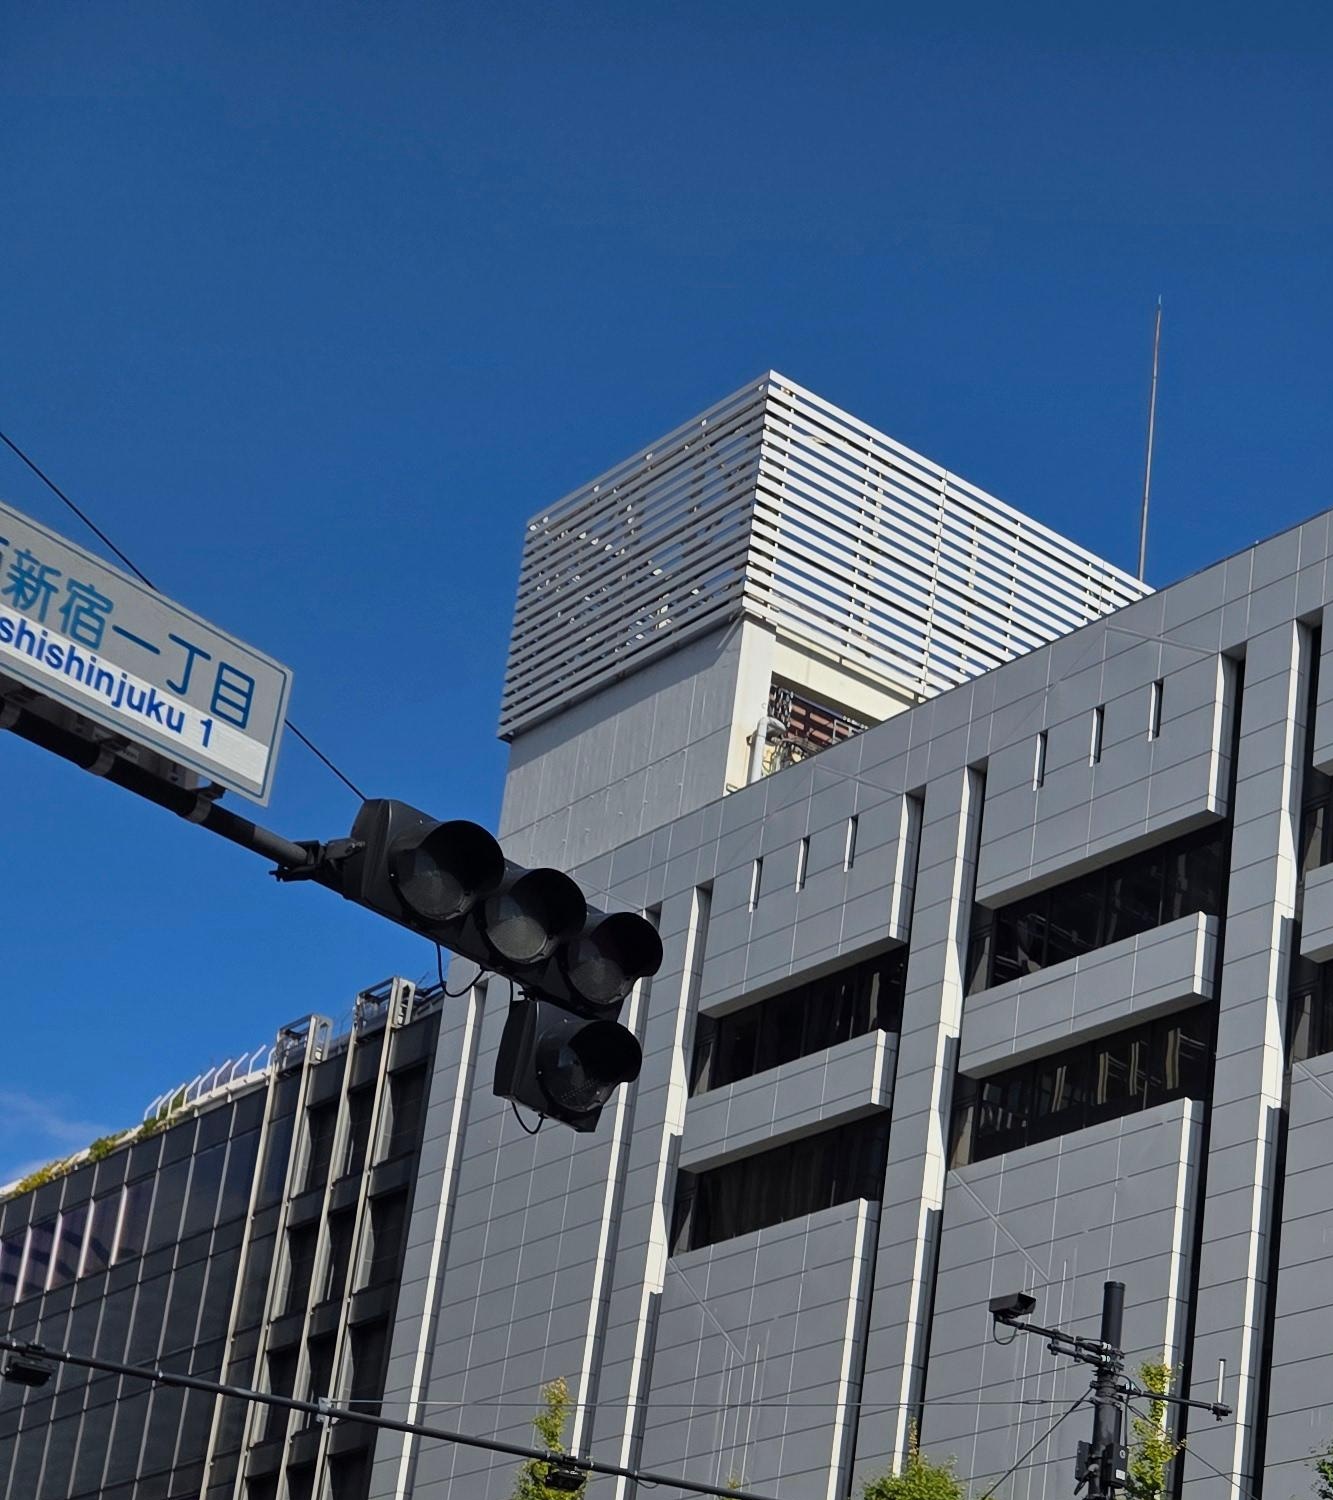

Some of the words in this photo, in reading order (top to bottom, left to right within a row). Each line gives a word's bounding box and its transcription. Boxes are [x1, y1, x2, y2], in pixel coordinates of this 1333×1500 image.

[0, 536, 256, 730] 新宿一丁目
[200, 717, 214, 748] 1
